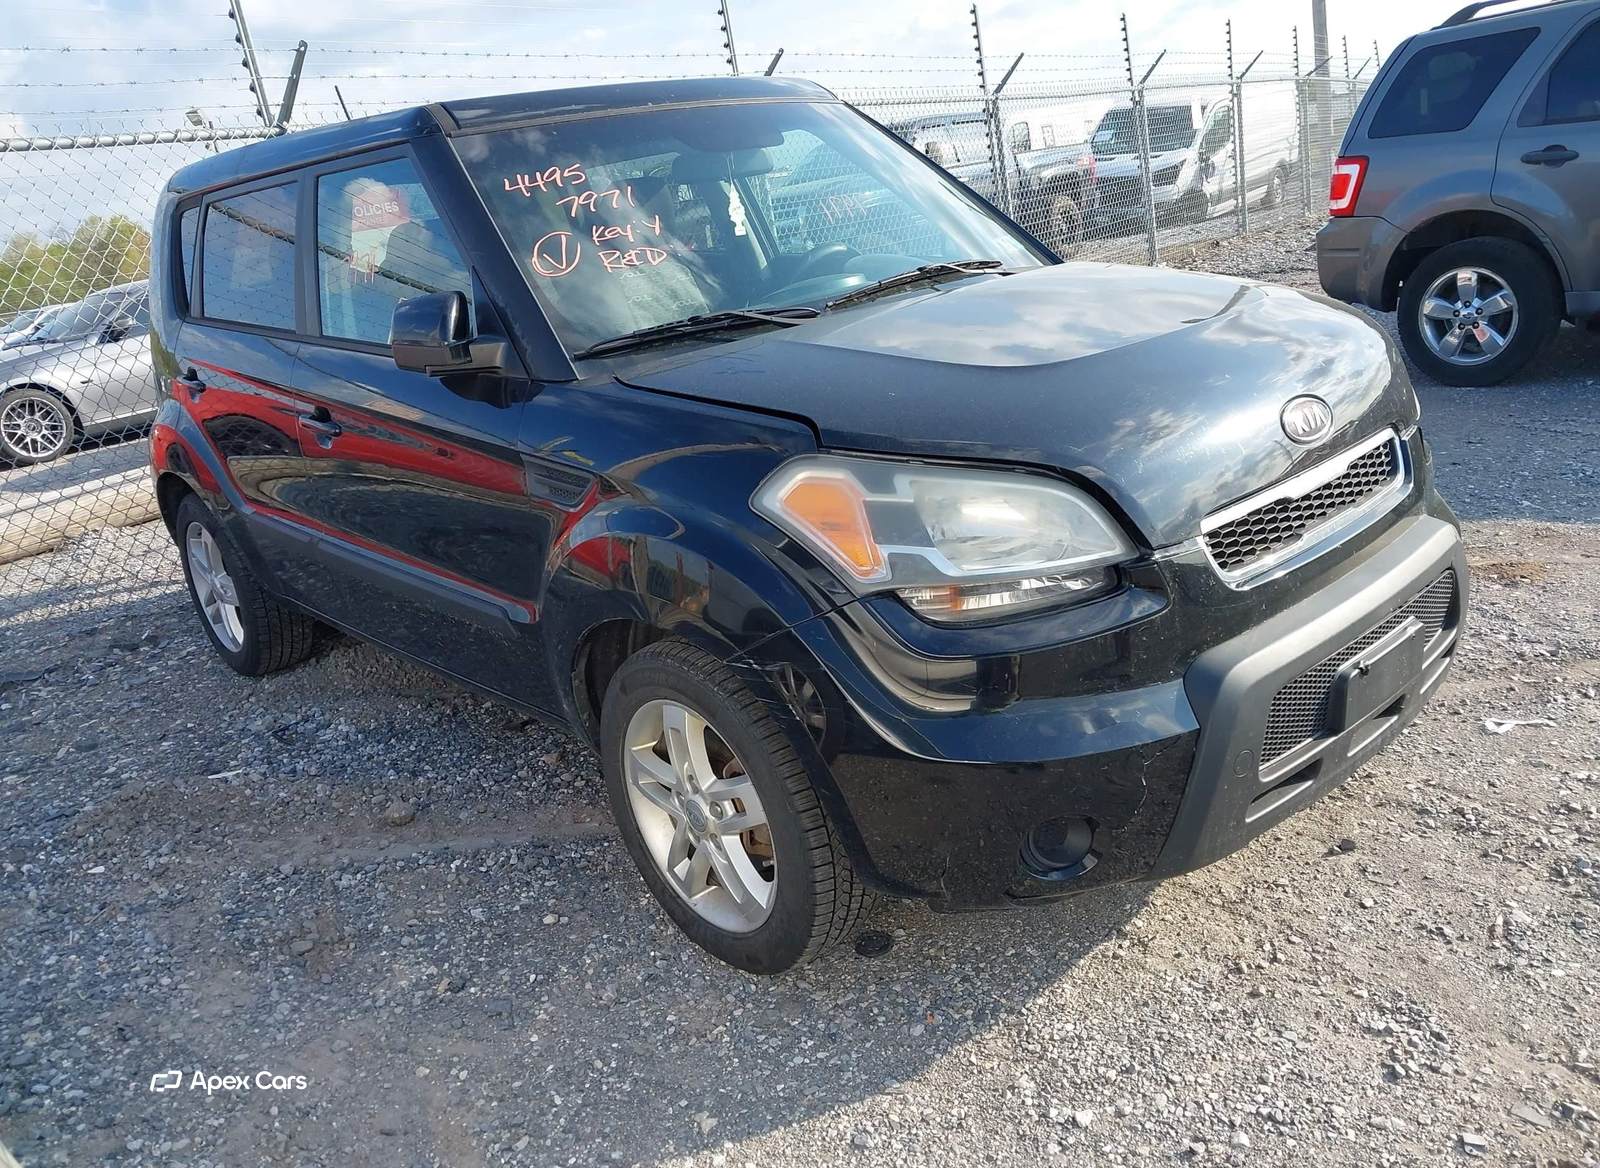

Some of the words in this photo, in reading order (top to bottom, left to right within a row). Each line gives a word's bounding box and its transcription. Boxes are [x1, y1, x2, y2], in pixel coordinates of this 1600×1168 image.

[503, 163, 586, 197] 4495
[555, 185, 635, 217] 7971
[1286, 403, 1329, 436] KIA
